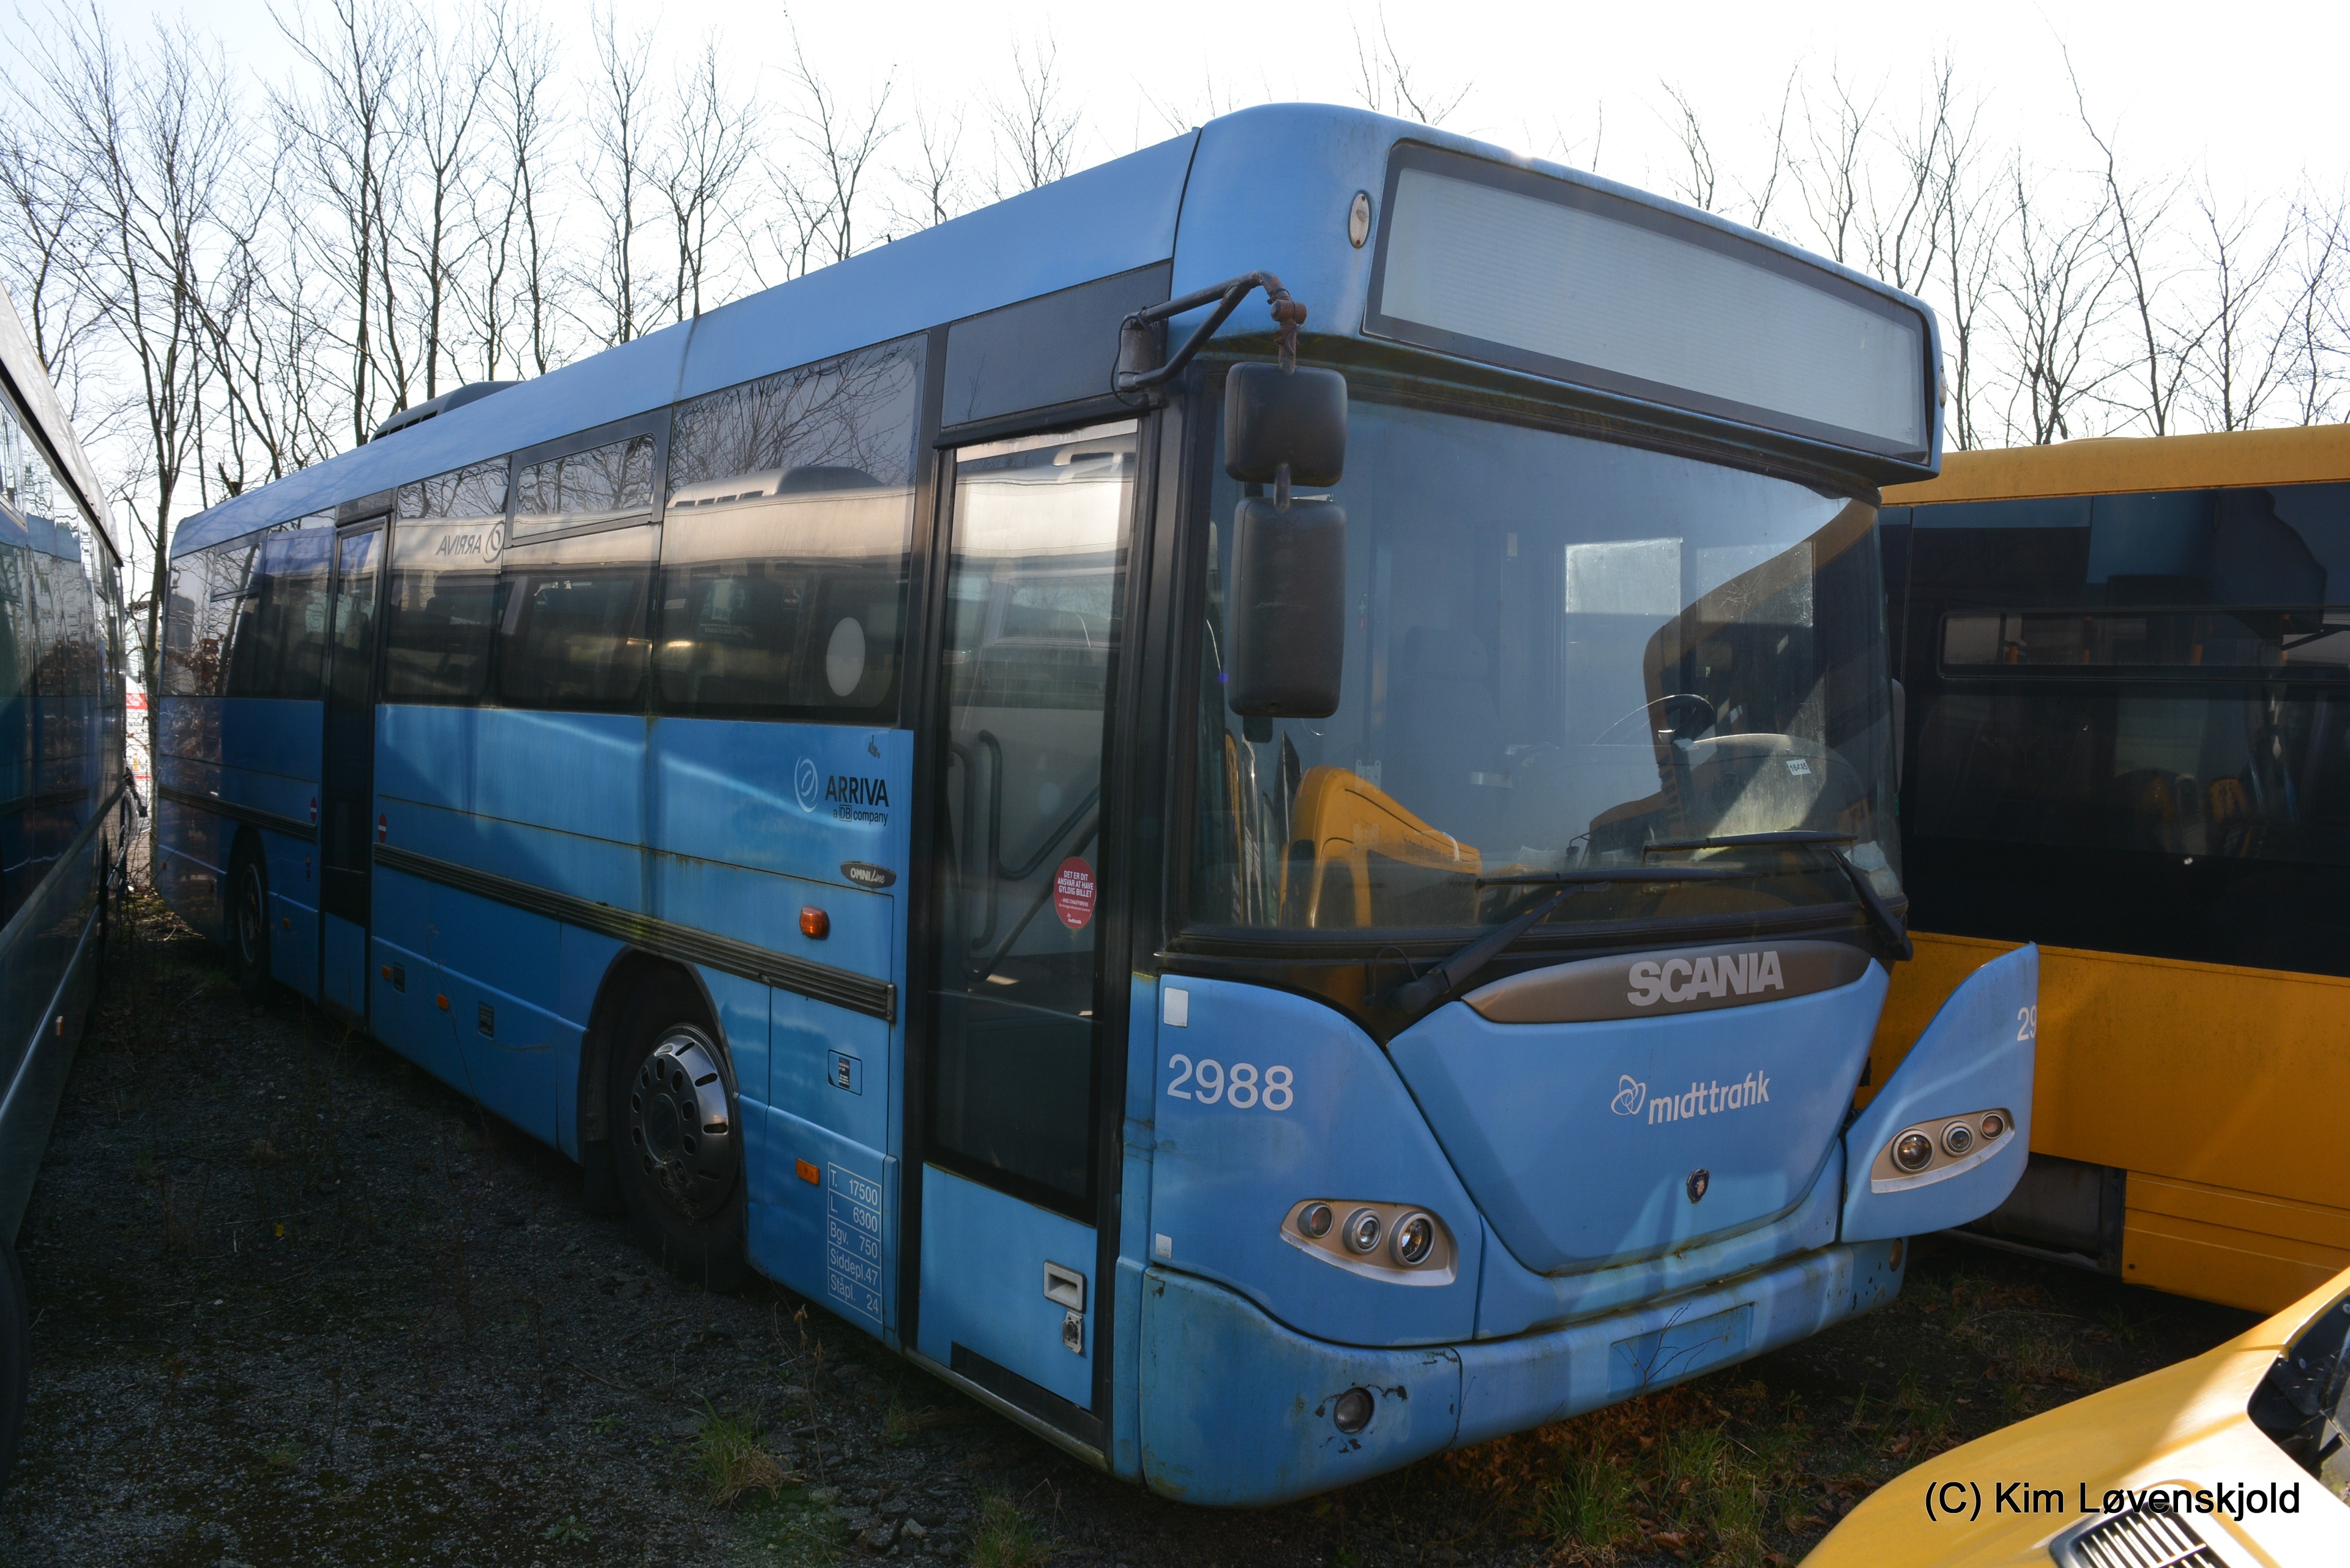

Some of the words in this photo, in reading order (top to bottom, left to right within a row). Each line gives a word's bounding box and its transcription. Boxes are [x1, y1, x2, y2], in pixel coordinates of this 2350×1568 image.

[825, 775, 889, 807] ARRIVA
[833, 808, 838, 819] a
[840, 805, 851, 821] DB
[853, 810, 888, 826] company
[1058, 878, 1075, 887] ANSVAR
[1081, 882, 1094, 890] HAVE
[1059, 886, 1075, 895] GYLDIG
[1076, 888, 1092, 898] BILLET
[1064, 870, 1073, 879] DET
[1627, 950, 1784, 1006] SCANIA
[1167, 1054, 1294, 1111] 2988
[1648, 1070, 1770, 1125] midttrafik
[830, 1169, 837, 1187] T.
[849, 1179, 878, 1206] 17500
[830, 1195, 838, 1213] L.
[853, 1206, 878, 1233] 6300
[830, 1221, 849, 1245] Bgv.
[859, 1235, 878, 1259] 750
[830, 1274, 856, 1301] Ståpl.
[866, 1294, 879, 1314] 24
